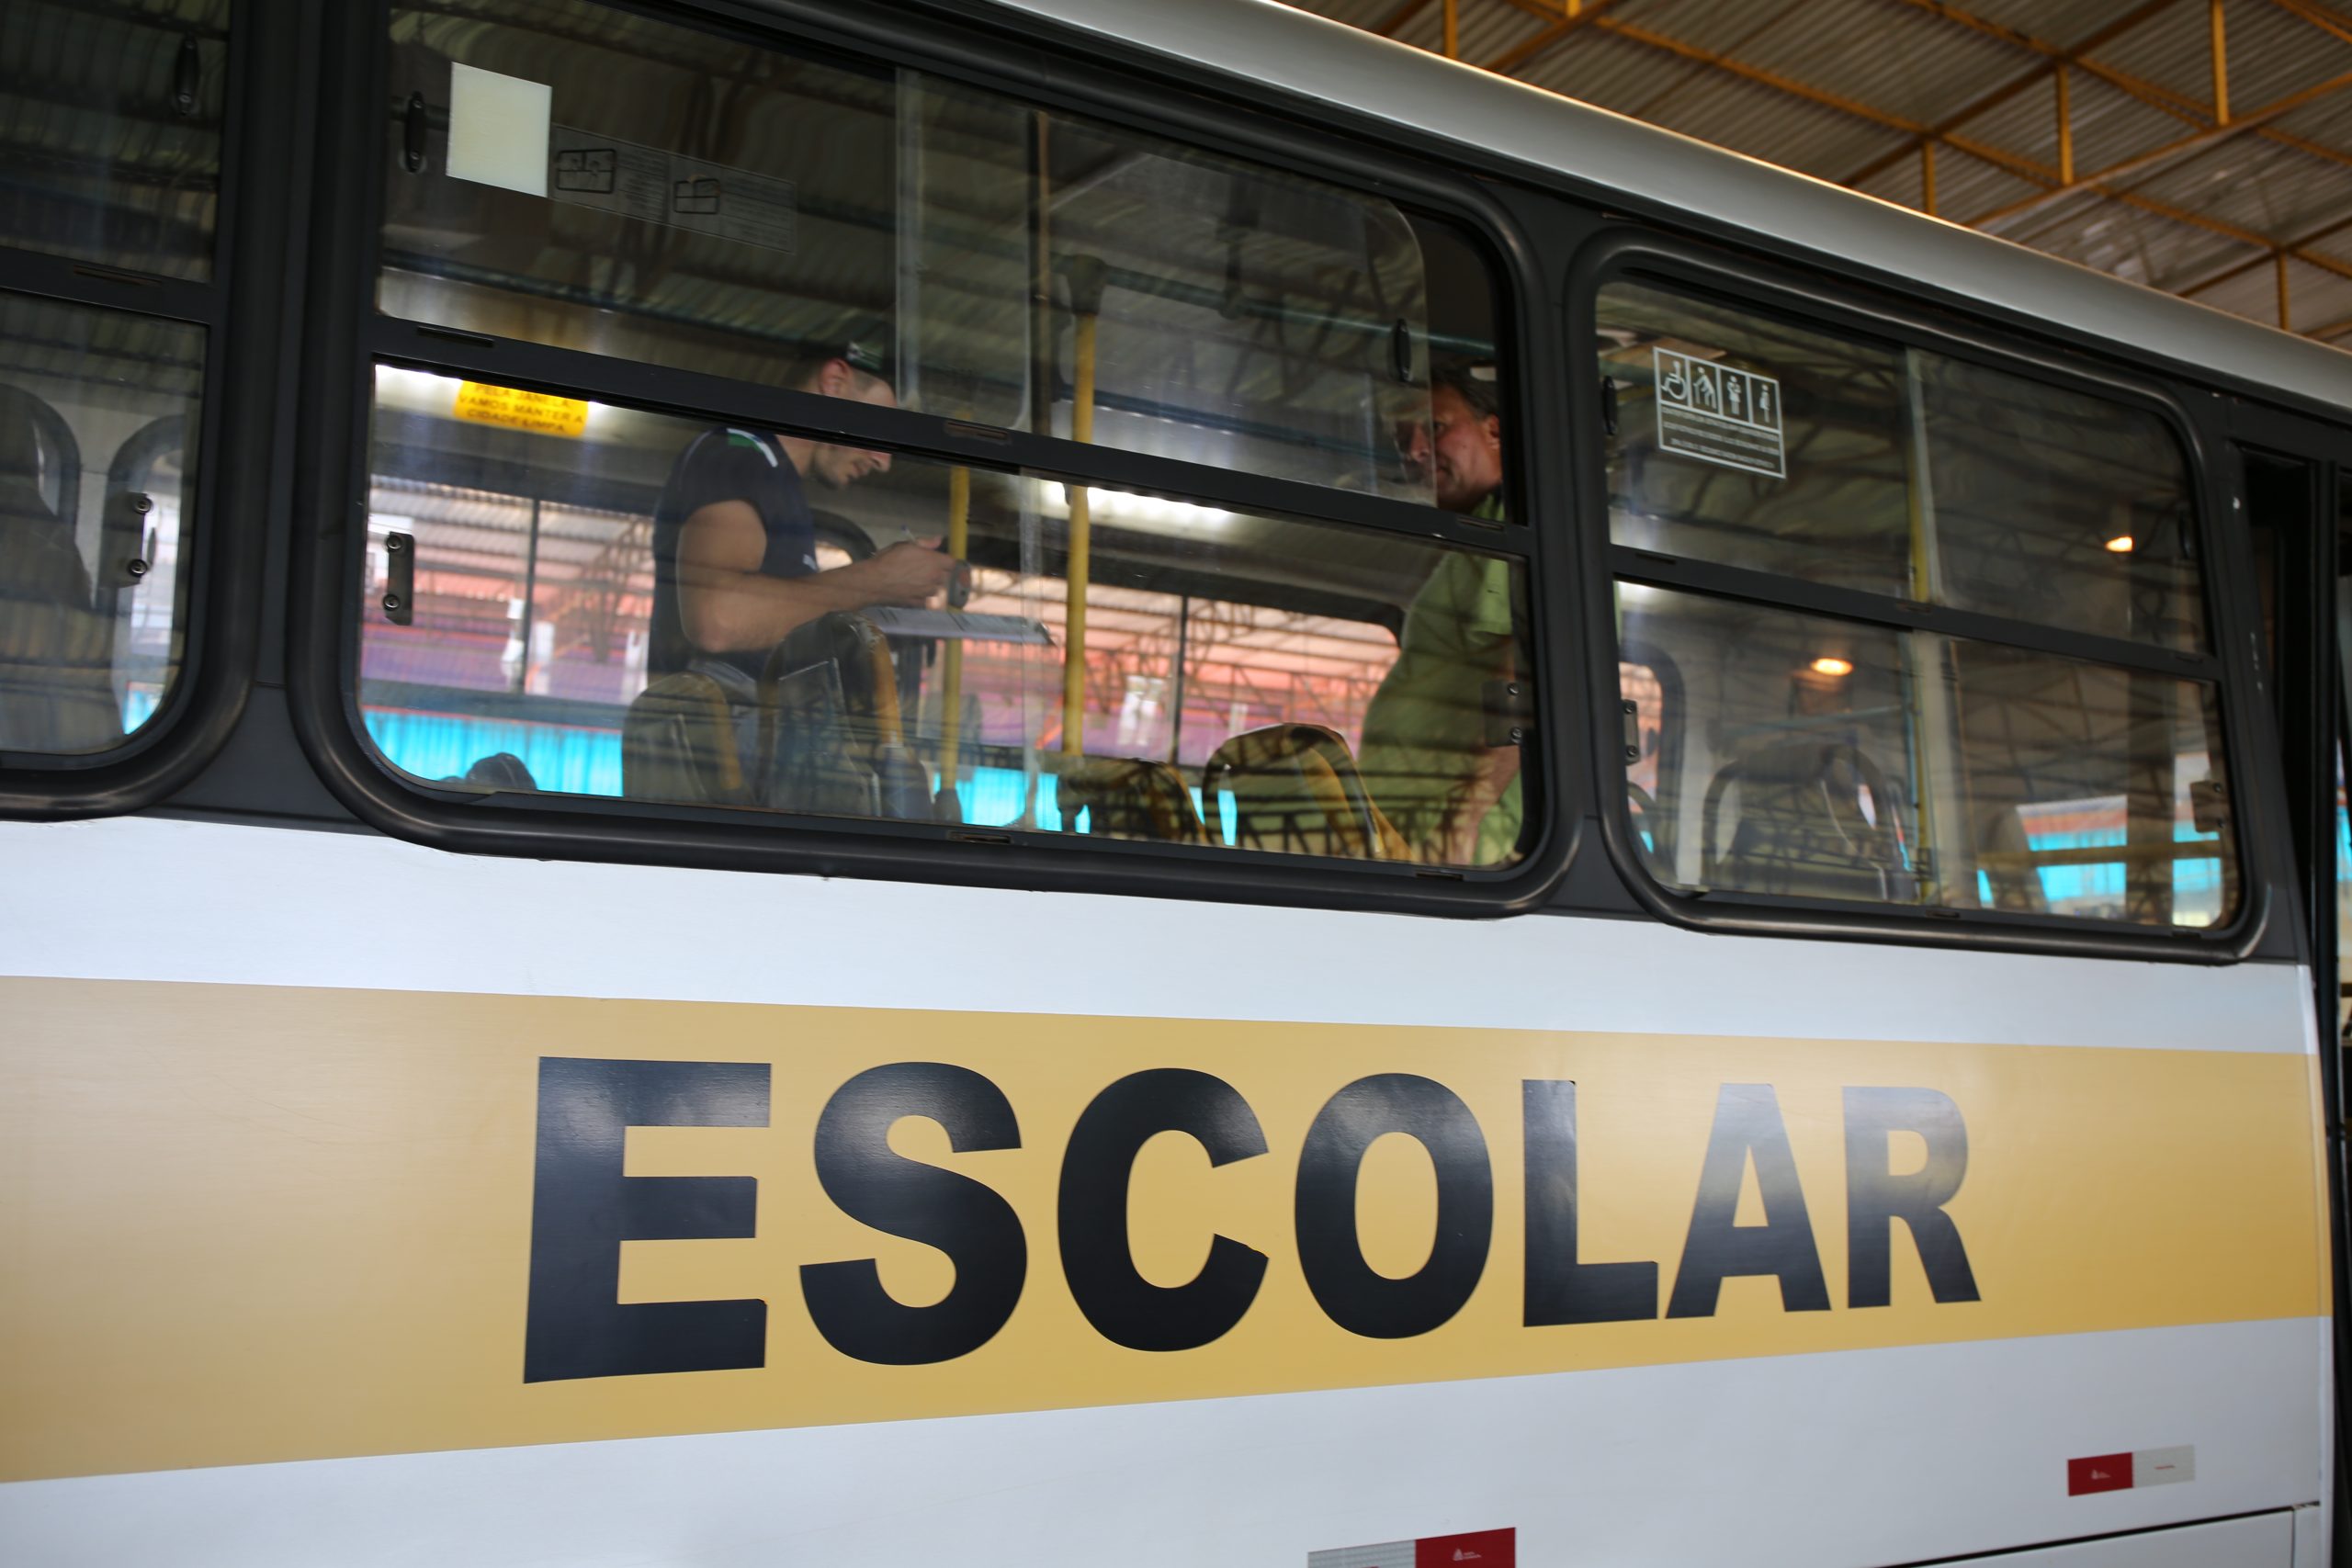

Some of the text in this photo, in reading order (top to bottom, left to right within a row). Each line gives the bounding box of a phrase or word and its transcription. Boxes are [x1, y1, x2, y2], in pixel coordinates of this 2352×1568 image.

[459, 395, 584, 423] VAMOS MANTER A
[467, 409, 517, 425] CIDADE
[524, 1055, 1980, 1383] ESCOLAR
